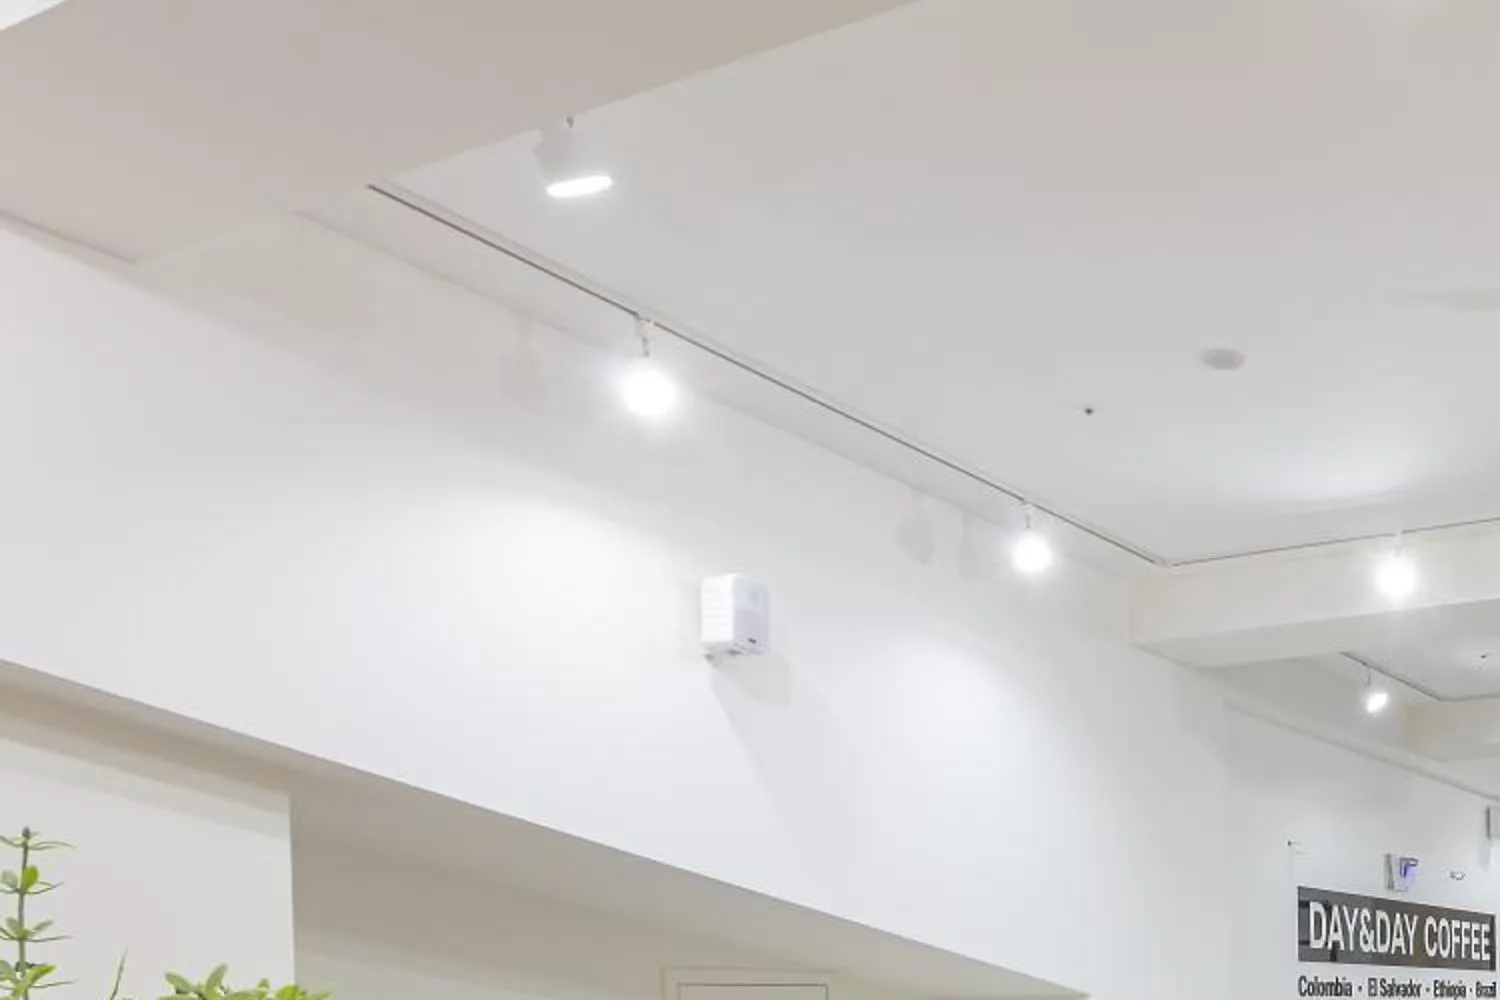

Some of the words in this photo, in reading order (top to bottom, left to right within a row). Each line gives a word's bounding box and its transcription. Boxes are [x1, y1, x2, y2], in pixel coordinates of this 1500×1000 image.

[1308, 901, 1419, 956] DAY&DAY
[1424, 916, 1491, 961] COFFEE
[1297, 975, 1353, 997] Colombia
[1367, 978, 1378, 997] El
[1380, 978, 1422, 998] Salvador
